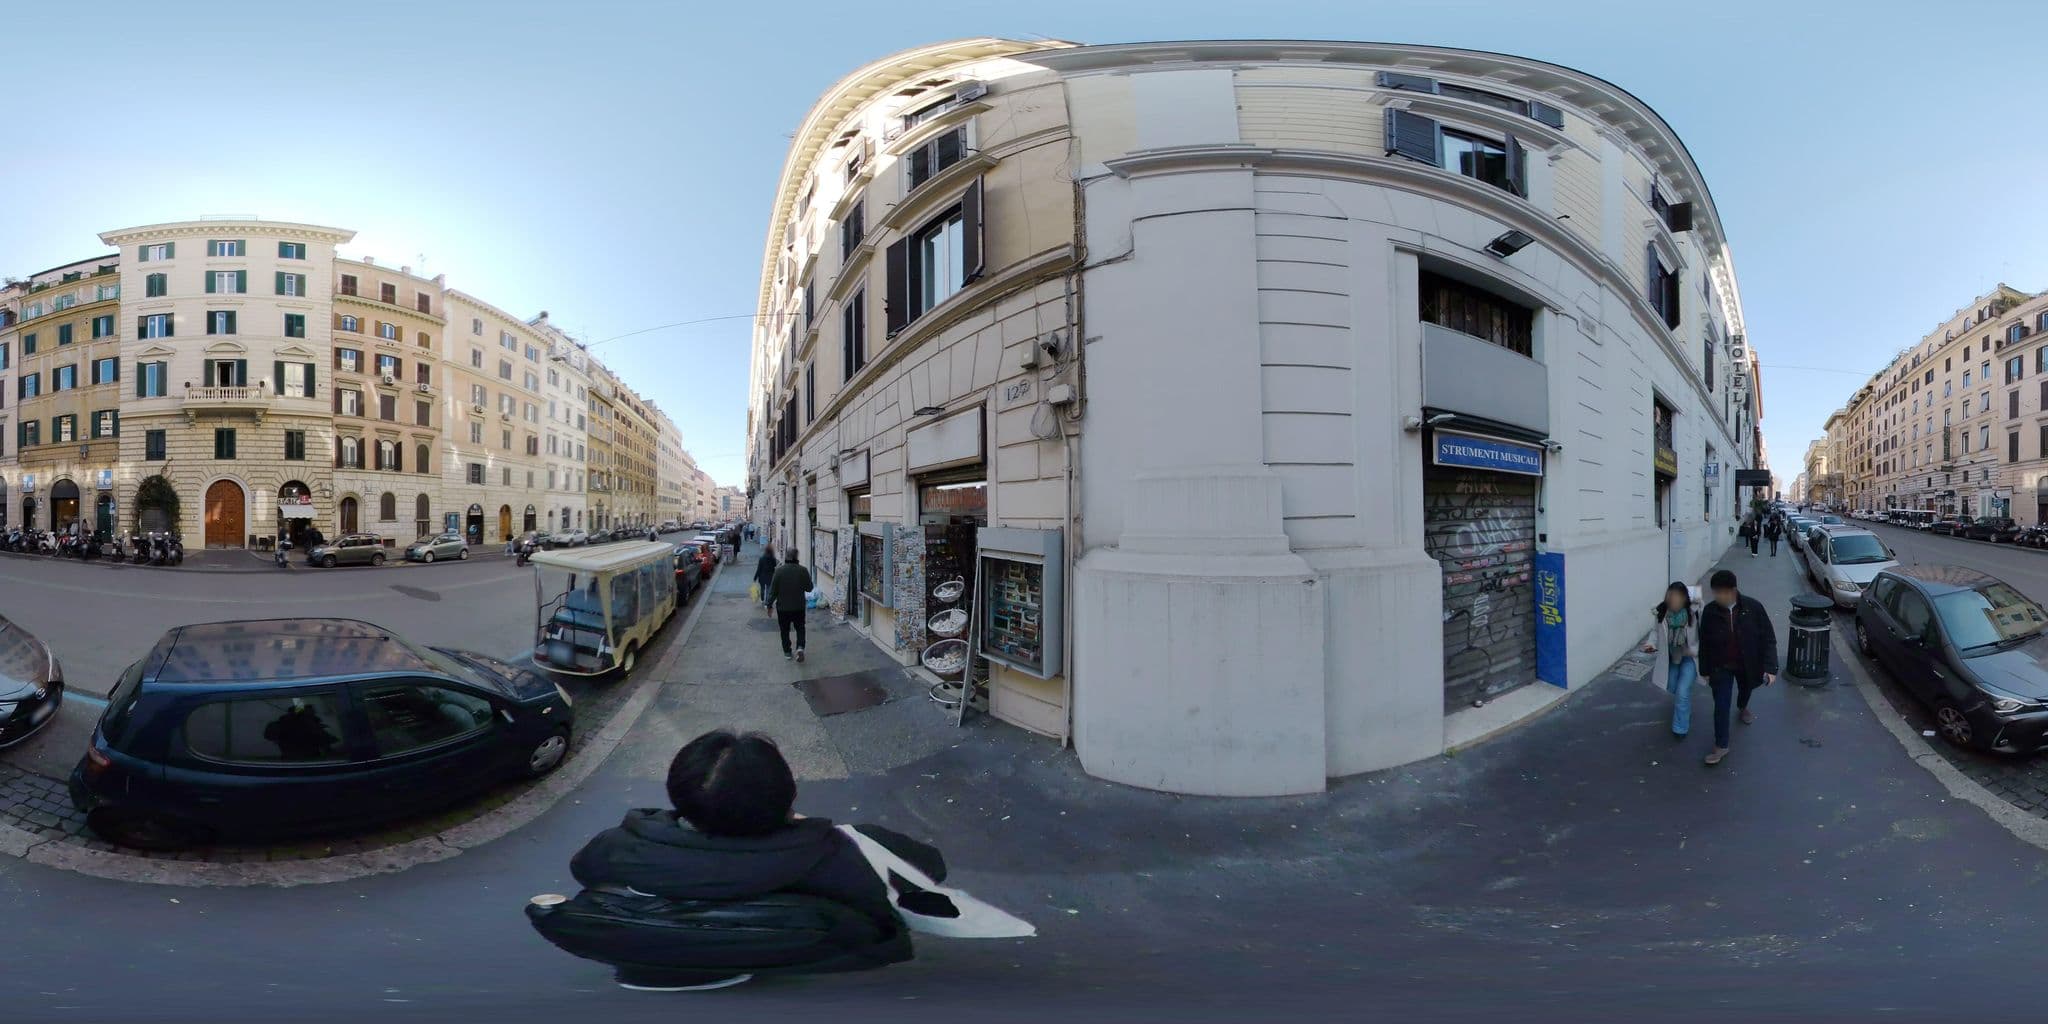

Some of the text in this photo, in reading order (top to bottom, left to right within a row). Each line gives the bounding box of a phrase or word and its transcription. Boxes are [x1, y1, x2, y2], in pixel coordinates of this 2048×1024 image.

[1732, 335, 1743, 403] HOTEL
[1442, 444, 1538, 466] STRUMENTI MUSICALI
